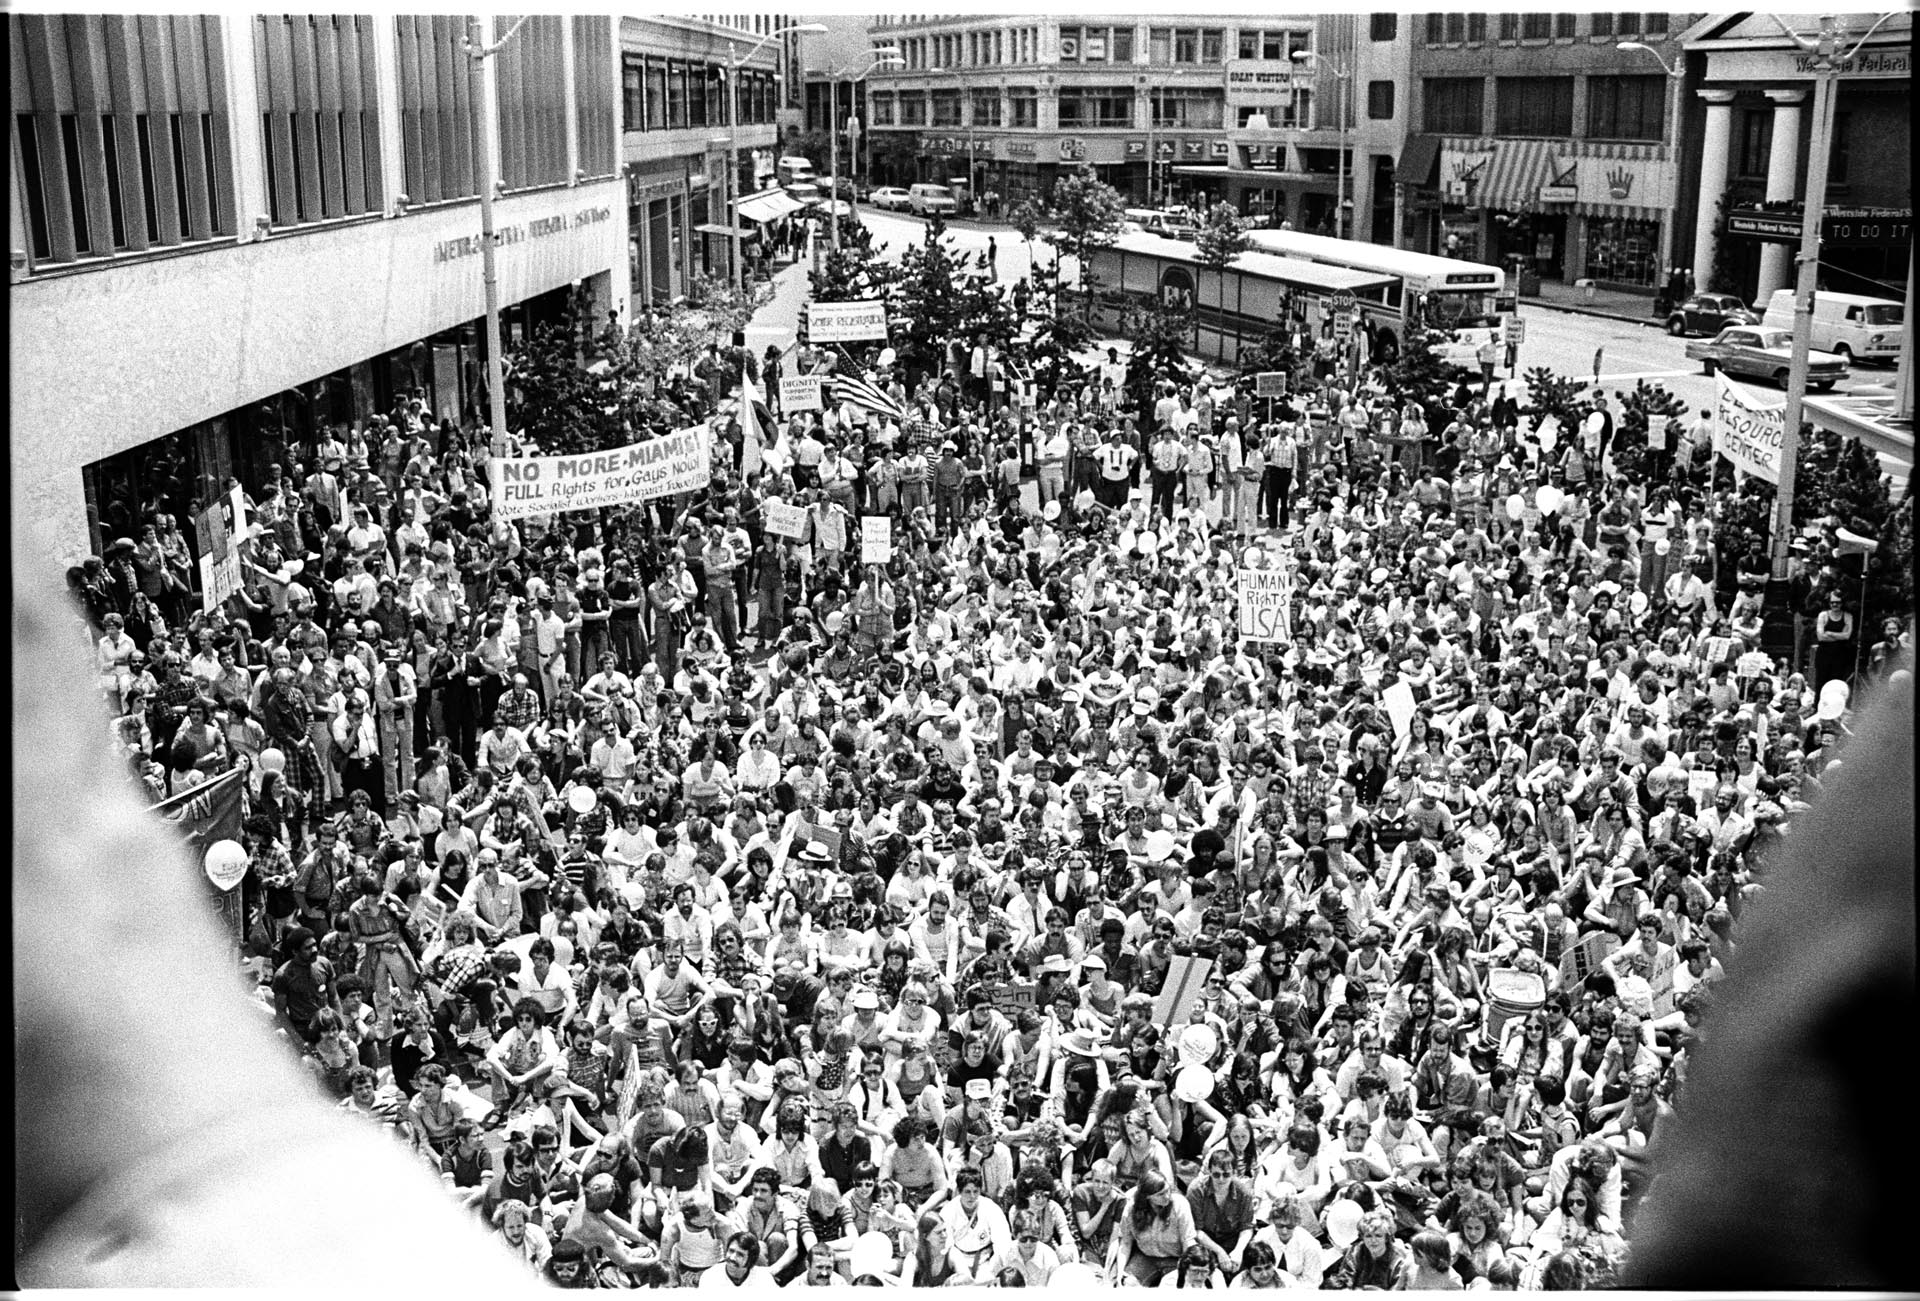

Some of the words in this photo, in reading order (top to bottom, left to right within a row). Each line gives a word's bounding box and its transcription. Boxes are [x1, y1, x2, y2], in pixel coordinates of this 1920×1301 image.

[1230, 72, 1254, 82] GREAT
[1256, 72, 1290, 83] WESTERN
[1832, 224, 1850, 238] TO
[1861, 224, 1880, 238] DO
[1891, 224, 1909, 238] IT
[1333, 295, 1355, 307] STOP
[783, 378, 818, 388] DIGNITY
[1719, 404, 1784, 449] RESOURC
[1724, 432, 1774, 470] CENTER
[503, 462, 541, 483] NO
[557, 453, 621, 479] MORE
[504, 484, 544, 500] FULL
[604, 475, 626, 491] for
[631, 466, 668, 485] Gays
[1240, 574, 1286, 590] HUMAN
